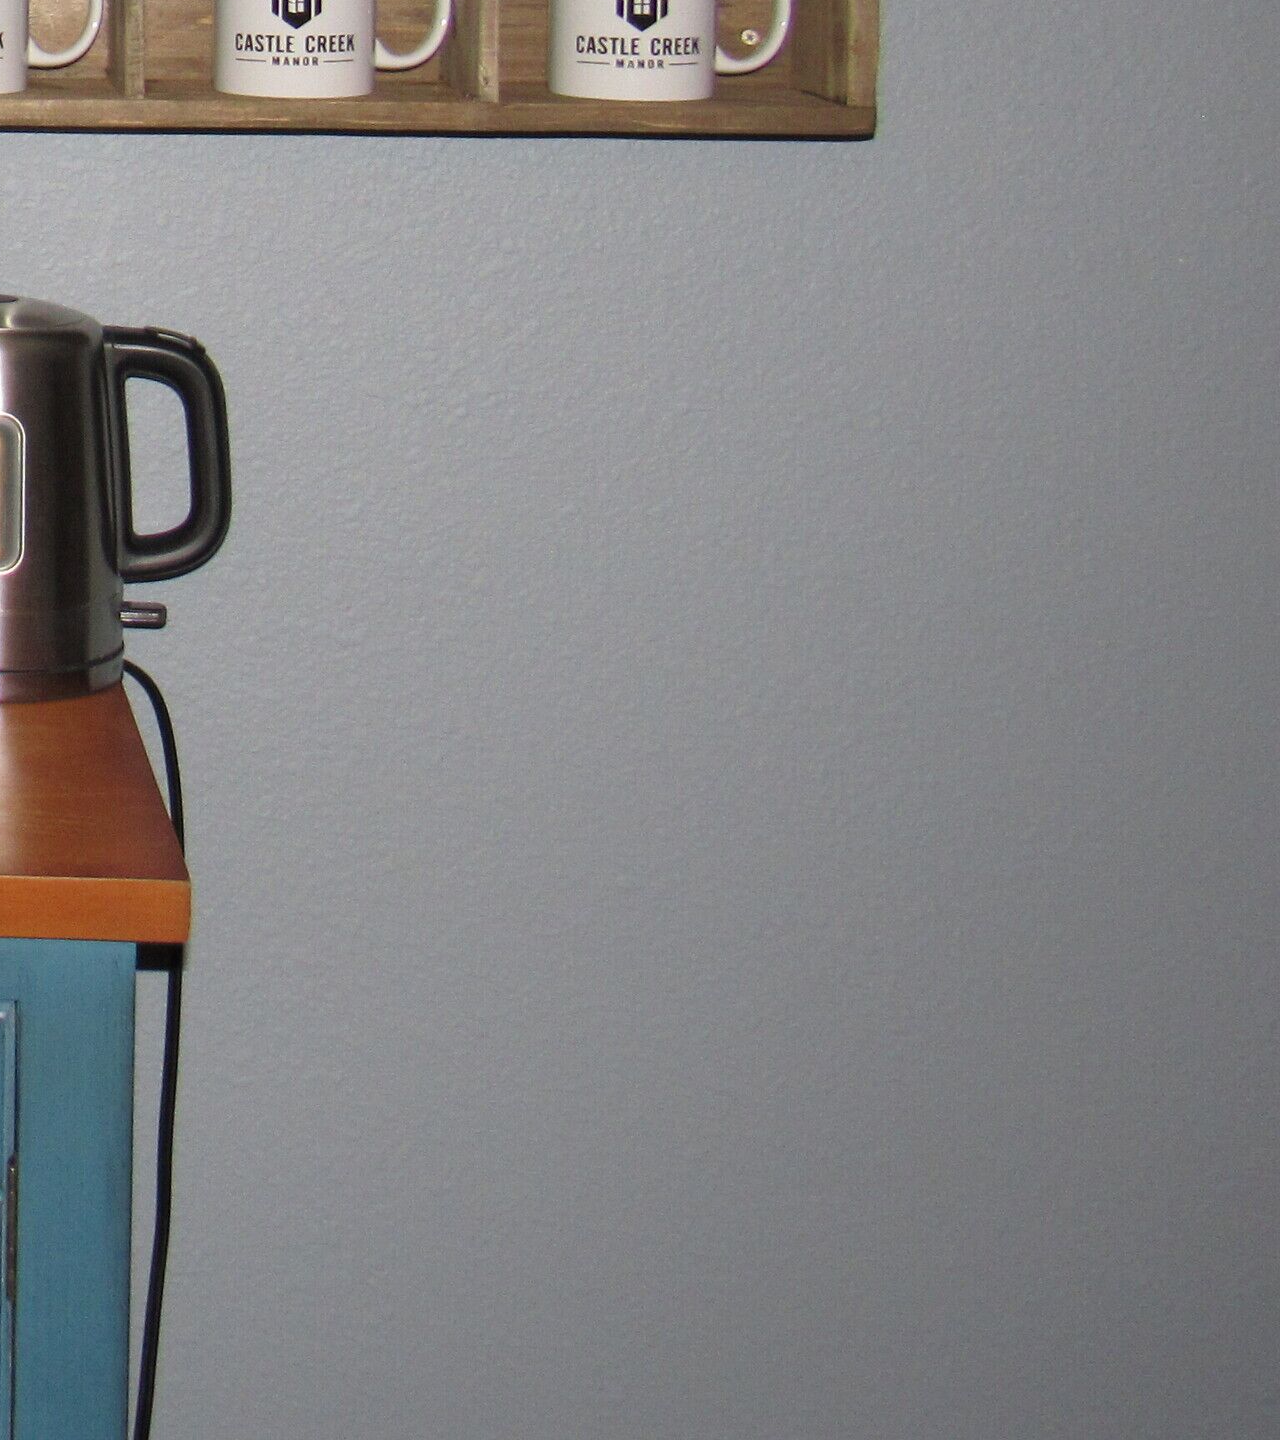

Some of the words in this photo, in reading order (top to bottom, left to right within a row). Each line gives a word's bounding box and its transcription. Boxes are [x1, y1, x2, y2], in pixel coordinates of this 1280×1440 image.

[235, 33, 295, 53] CASTLE
[305, 34, 355, 53] CREEK
[576, 35, 640, 56] CASTLE
[650, 37, 701, 56] CREEK
[272, 57, 319, 66] MANOR
[615, 59, 665, 69] MANOR
